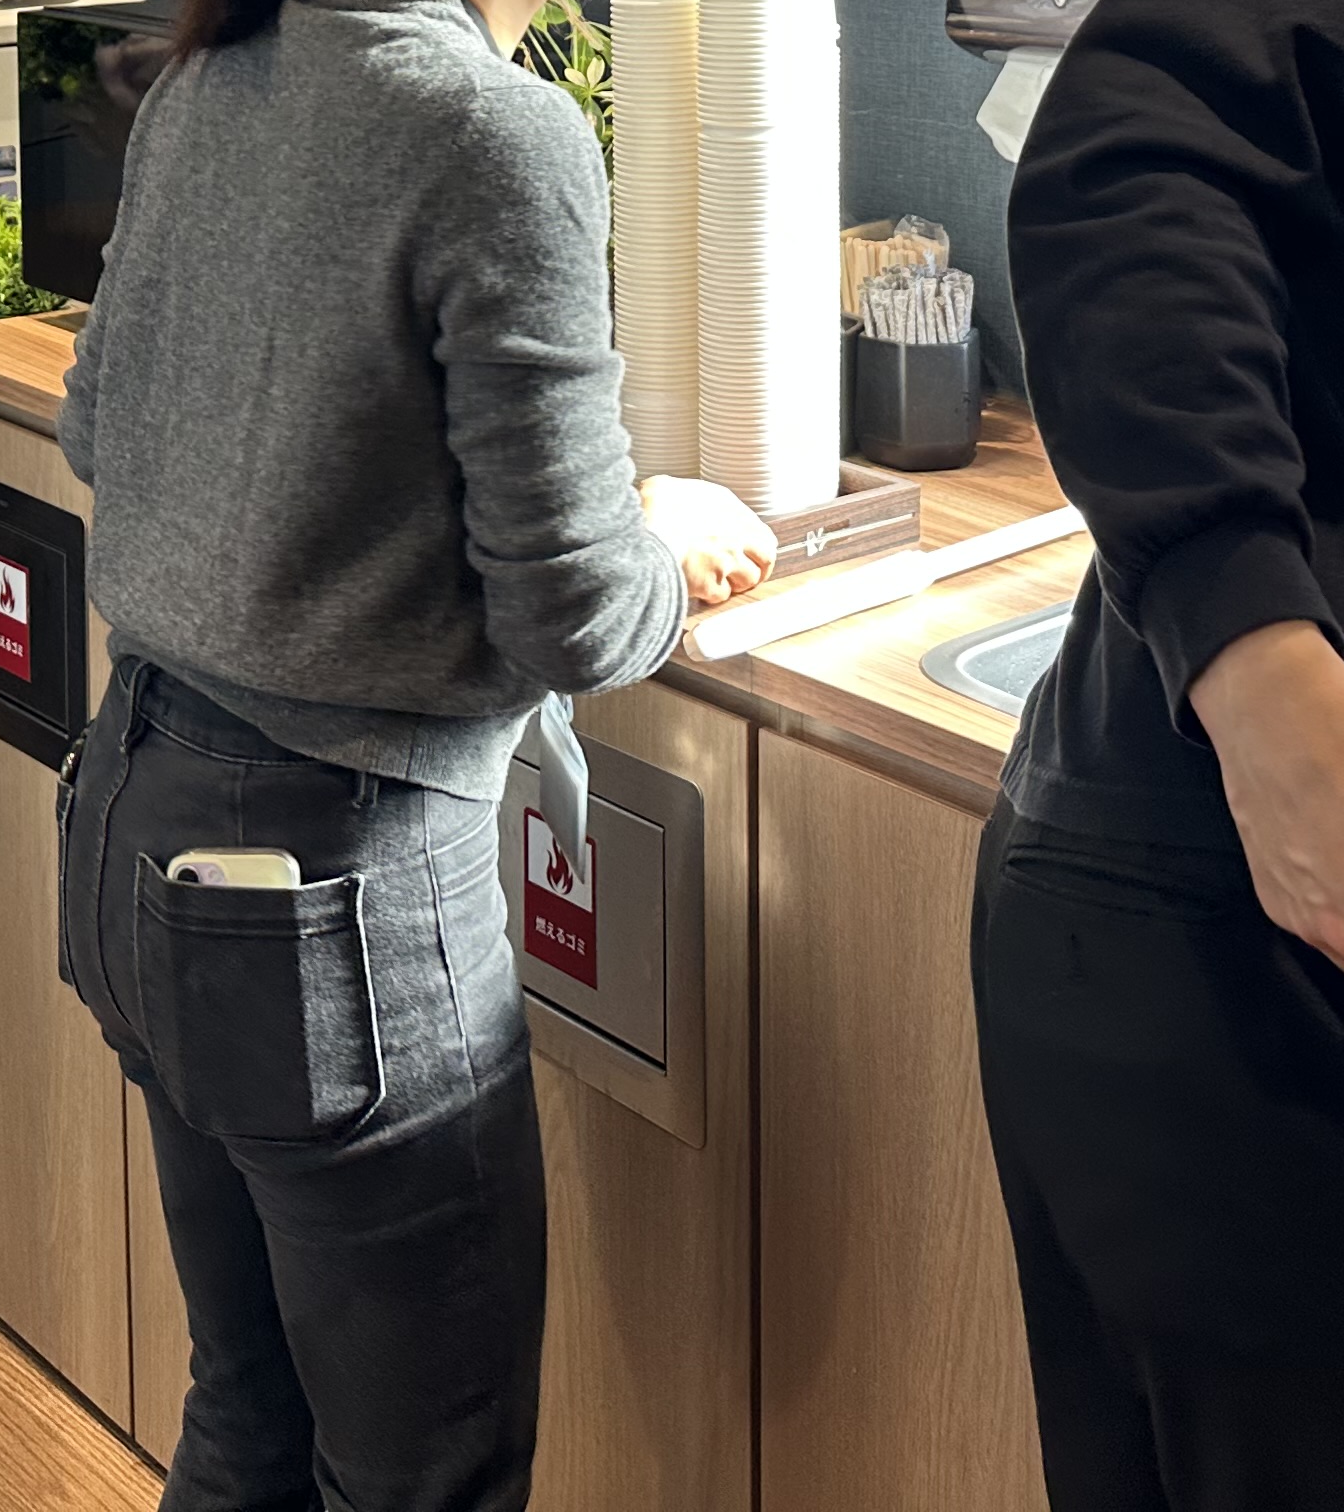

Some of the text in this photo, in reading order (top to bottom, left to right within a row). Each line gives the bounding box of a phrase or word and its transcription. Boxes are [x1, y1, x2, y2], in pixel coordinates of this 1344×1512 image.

[535, 915, 586, 956] 燃えるゴミ
